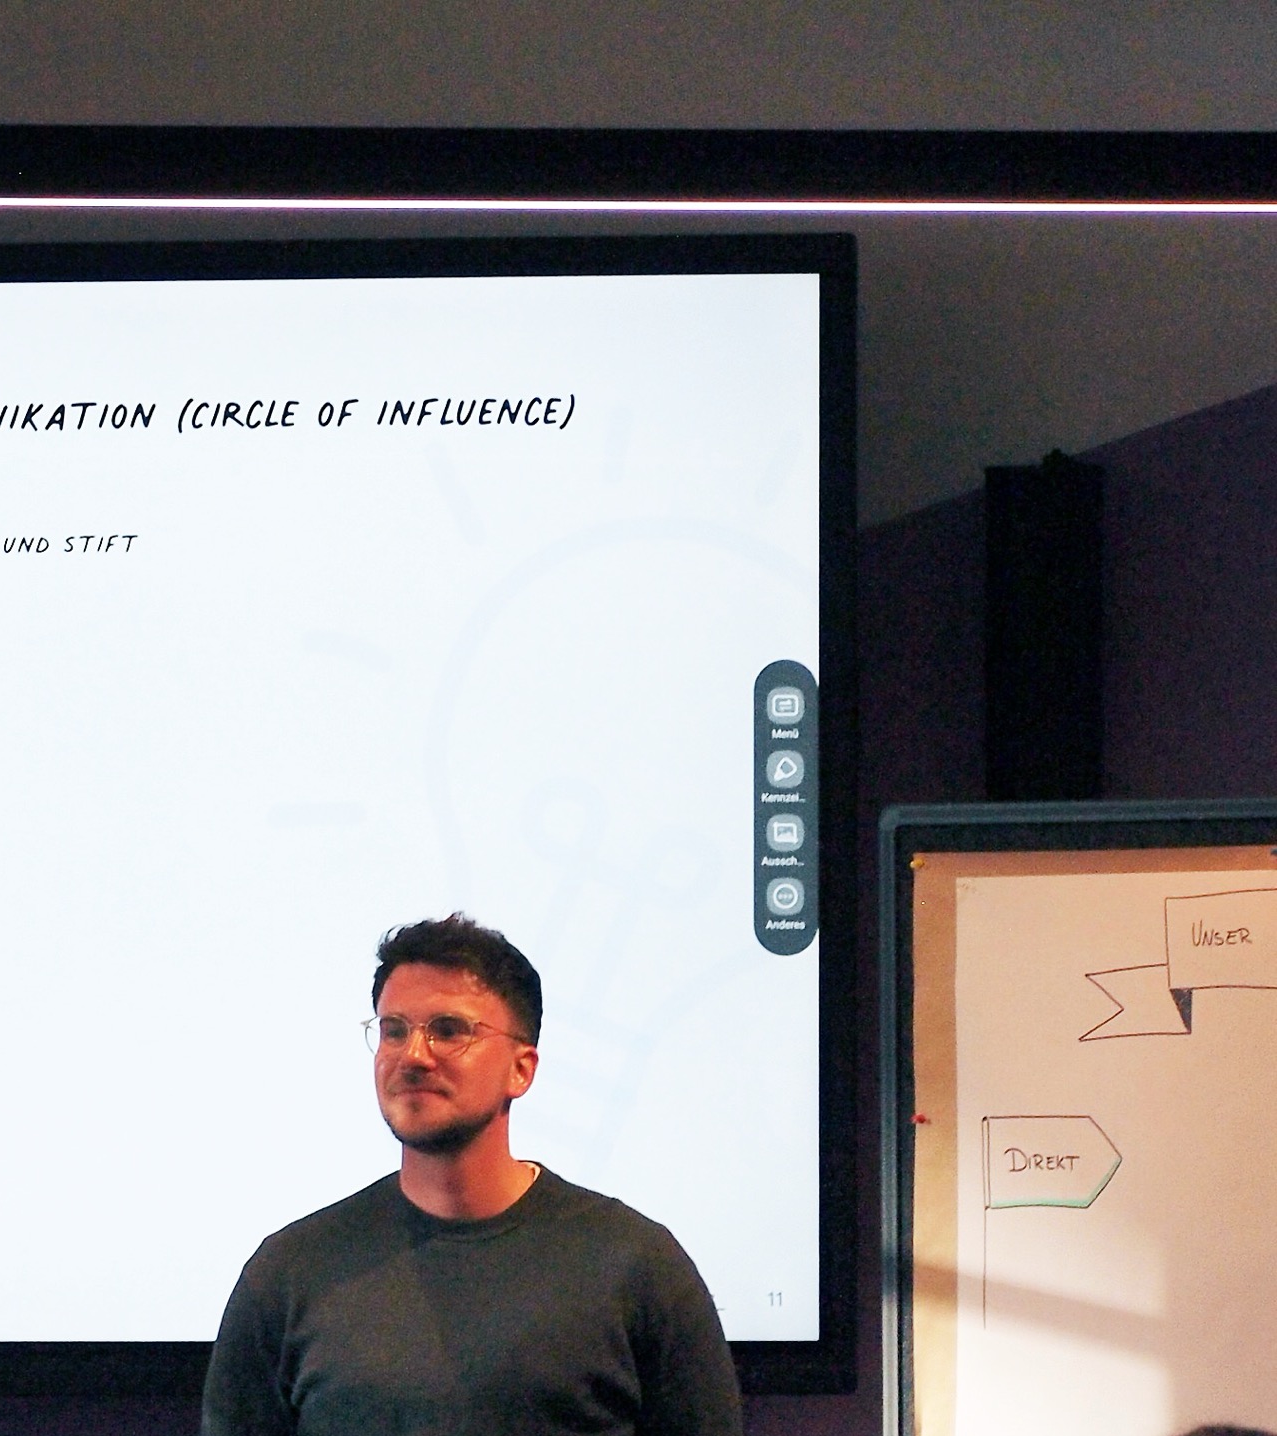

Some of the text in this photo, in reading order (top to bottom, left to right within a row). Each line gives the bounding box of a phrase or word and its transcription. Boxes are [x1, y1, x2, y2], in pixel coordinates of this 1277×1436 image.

[176, 396, 301, 435] (CIRCLE
[316, 397, 361, 429] OF
[375, 392, 577, 432] INFLUENCE)
[2, 535, 51, 555] UND
[62, 533, 140, 554] STIFT
[1191, 919, 1253, 947] UNSER
[1003, 1147, 1080, 1173] DIREKT
[767, 1291, 783, 1307] 11
